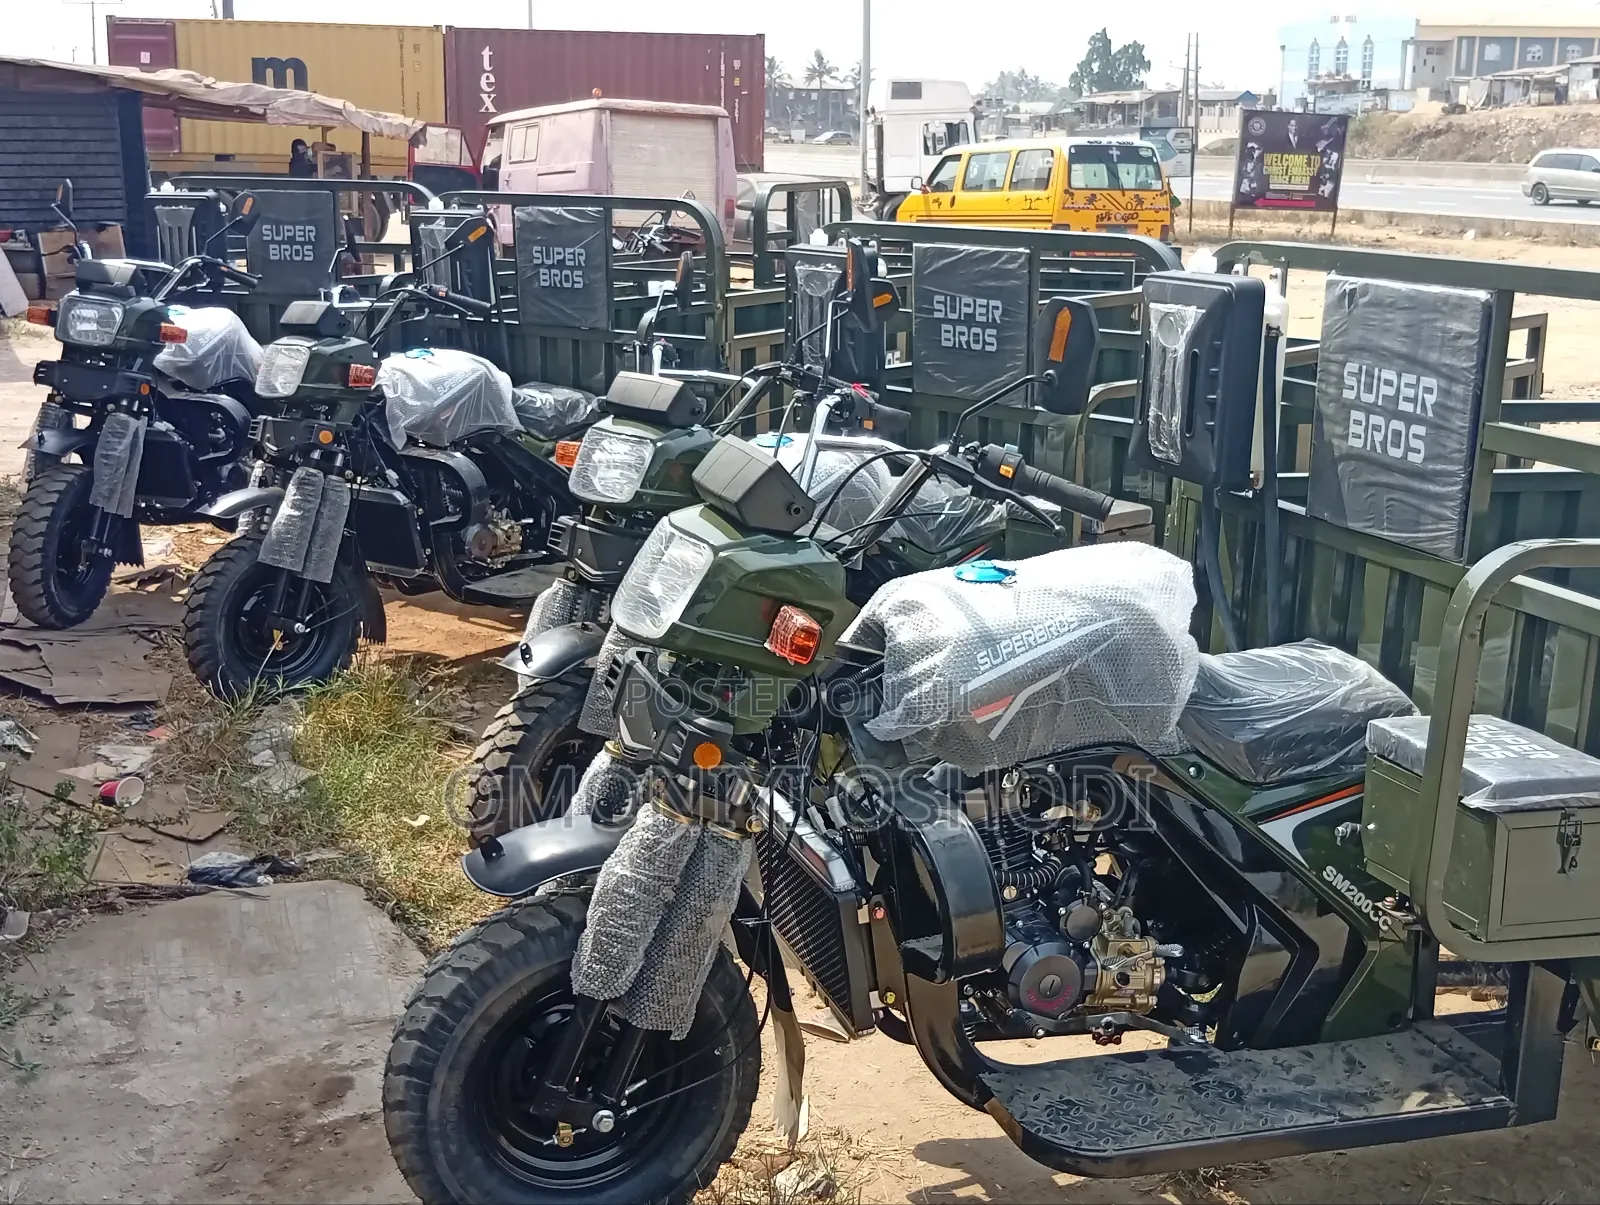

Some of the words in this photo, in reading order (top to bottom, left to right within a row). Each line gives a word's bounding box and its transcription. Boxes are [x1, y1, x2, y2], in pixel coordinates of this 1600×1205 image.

[479, 45, 499, 113] tex
[1262, 165, 1287, 176] CHRIST
[1288, 166, 1318, 177] EMBASSY
[1263, 153, 1308, 169] WELCOME
[1310, 155, 1321, 169] TO
[262, 224, 316, 242] SUPER
[269, 244, 314, 261] BROS
[532, 245, 586, 267] SUPER
[539, 268, 584, 289] BROS
[933, 295, 1003, 324] SUPER
[941, 323, 997, 352] BROS
[1342, 362, 1438, 418] SUPER
[1347, 409, 1427, 464] BROS
[976, 615, 1078, 672] SUPERBROS
[1468, 725, 1560, 759] SUPER
[1322, 865, 1392, 932] SM200CC
